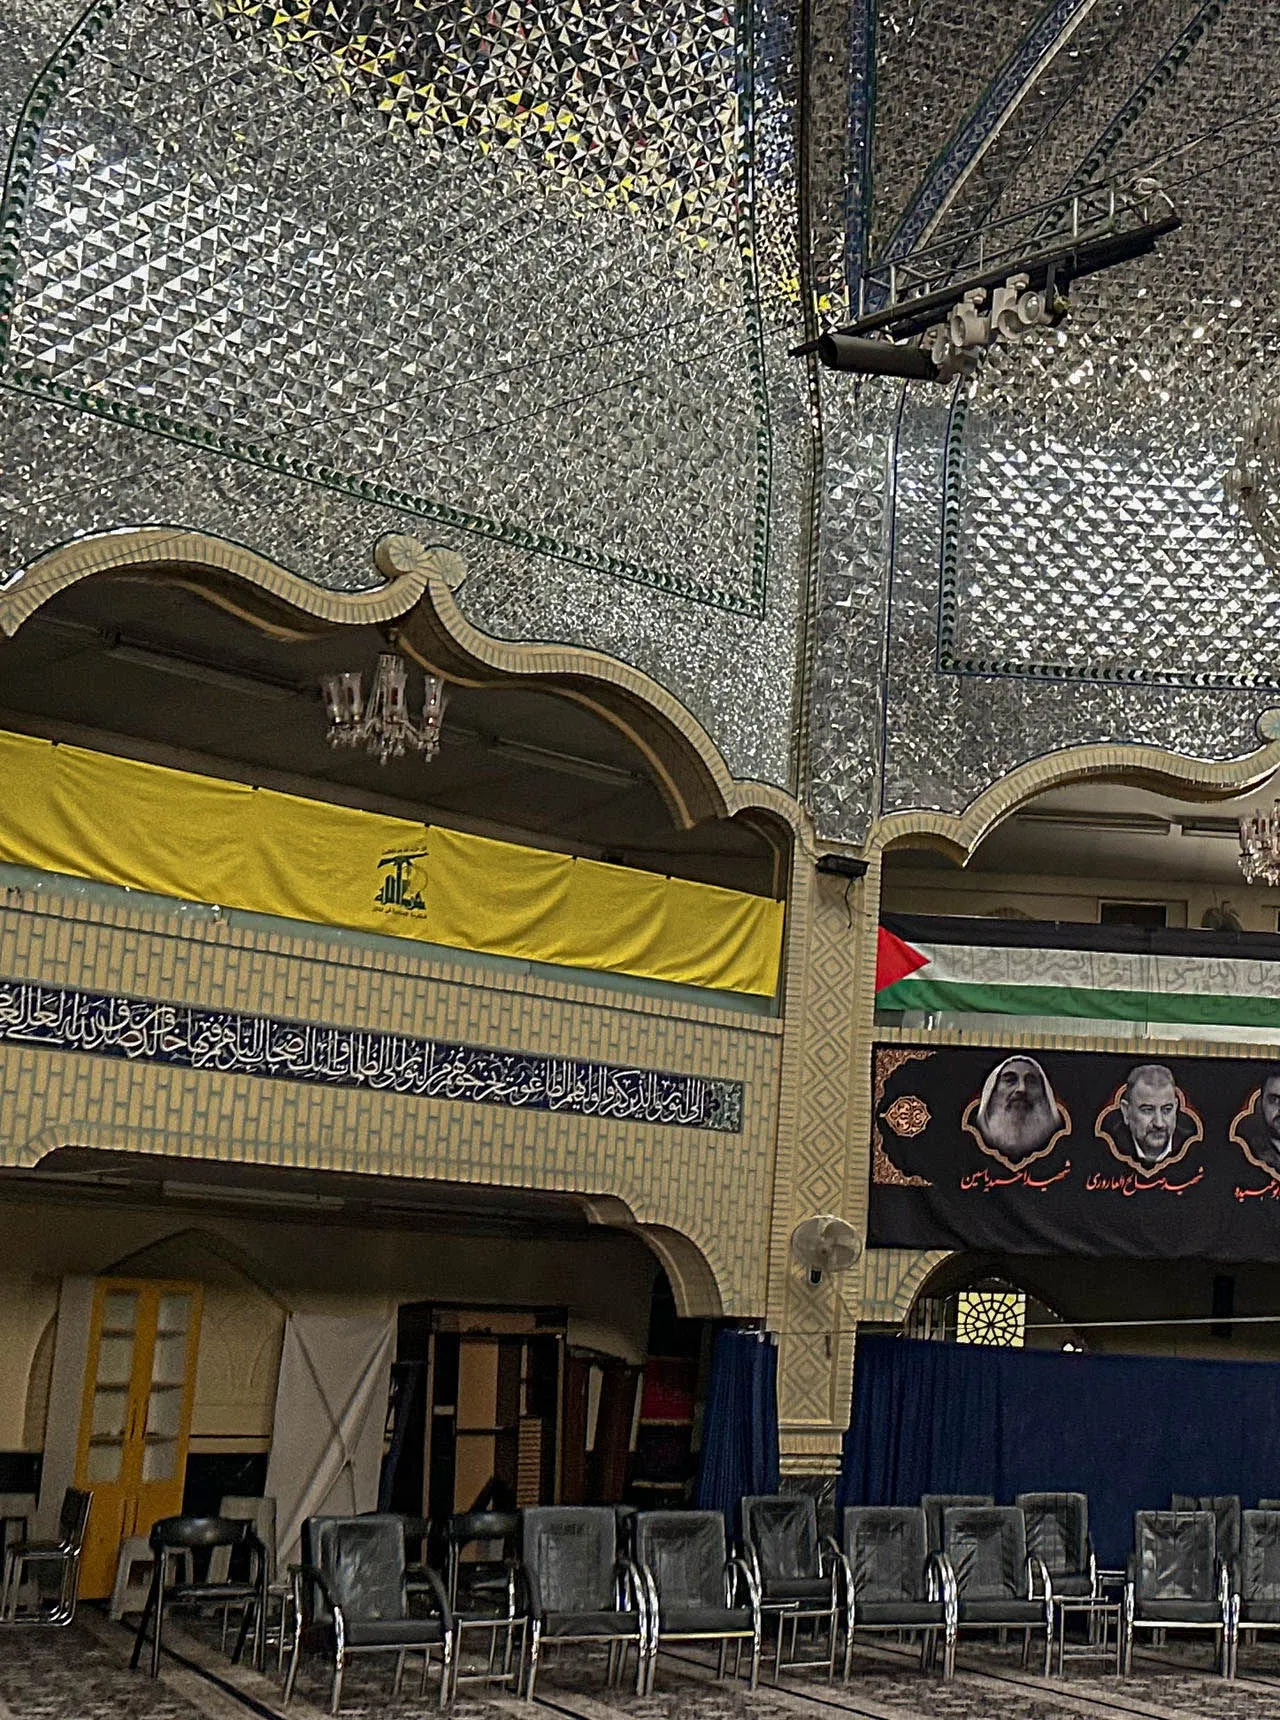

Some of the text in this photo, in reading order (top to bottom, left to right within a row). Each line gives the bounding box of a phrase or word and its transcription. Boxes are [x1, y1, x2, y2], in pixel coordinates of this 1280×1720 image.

[960, 1168, 989, 1191] یاسین
[1023, 1160, 1070, 1191] شهید
[1161, 1166, 1204, 1195] شهید
